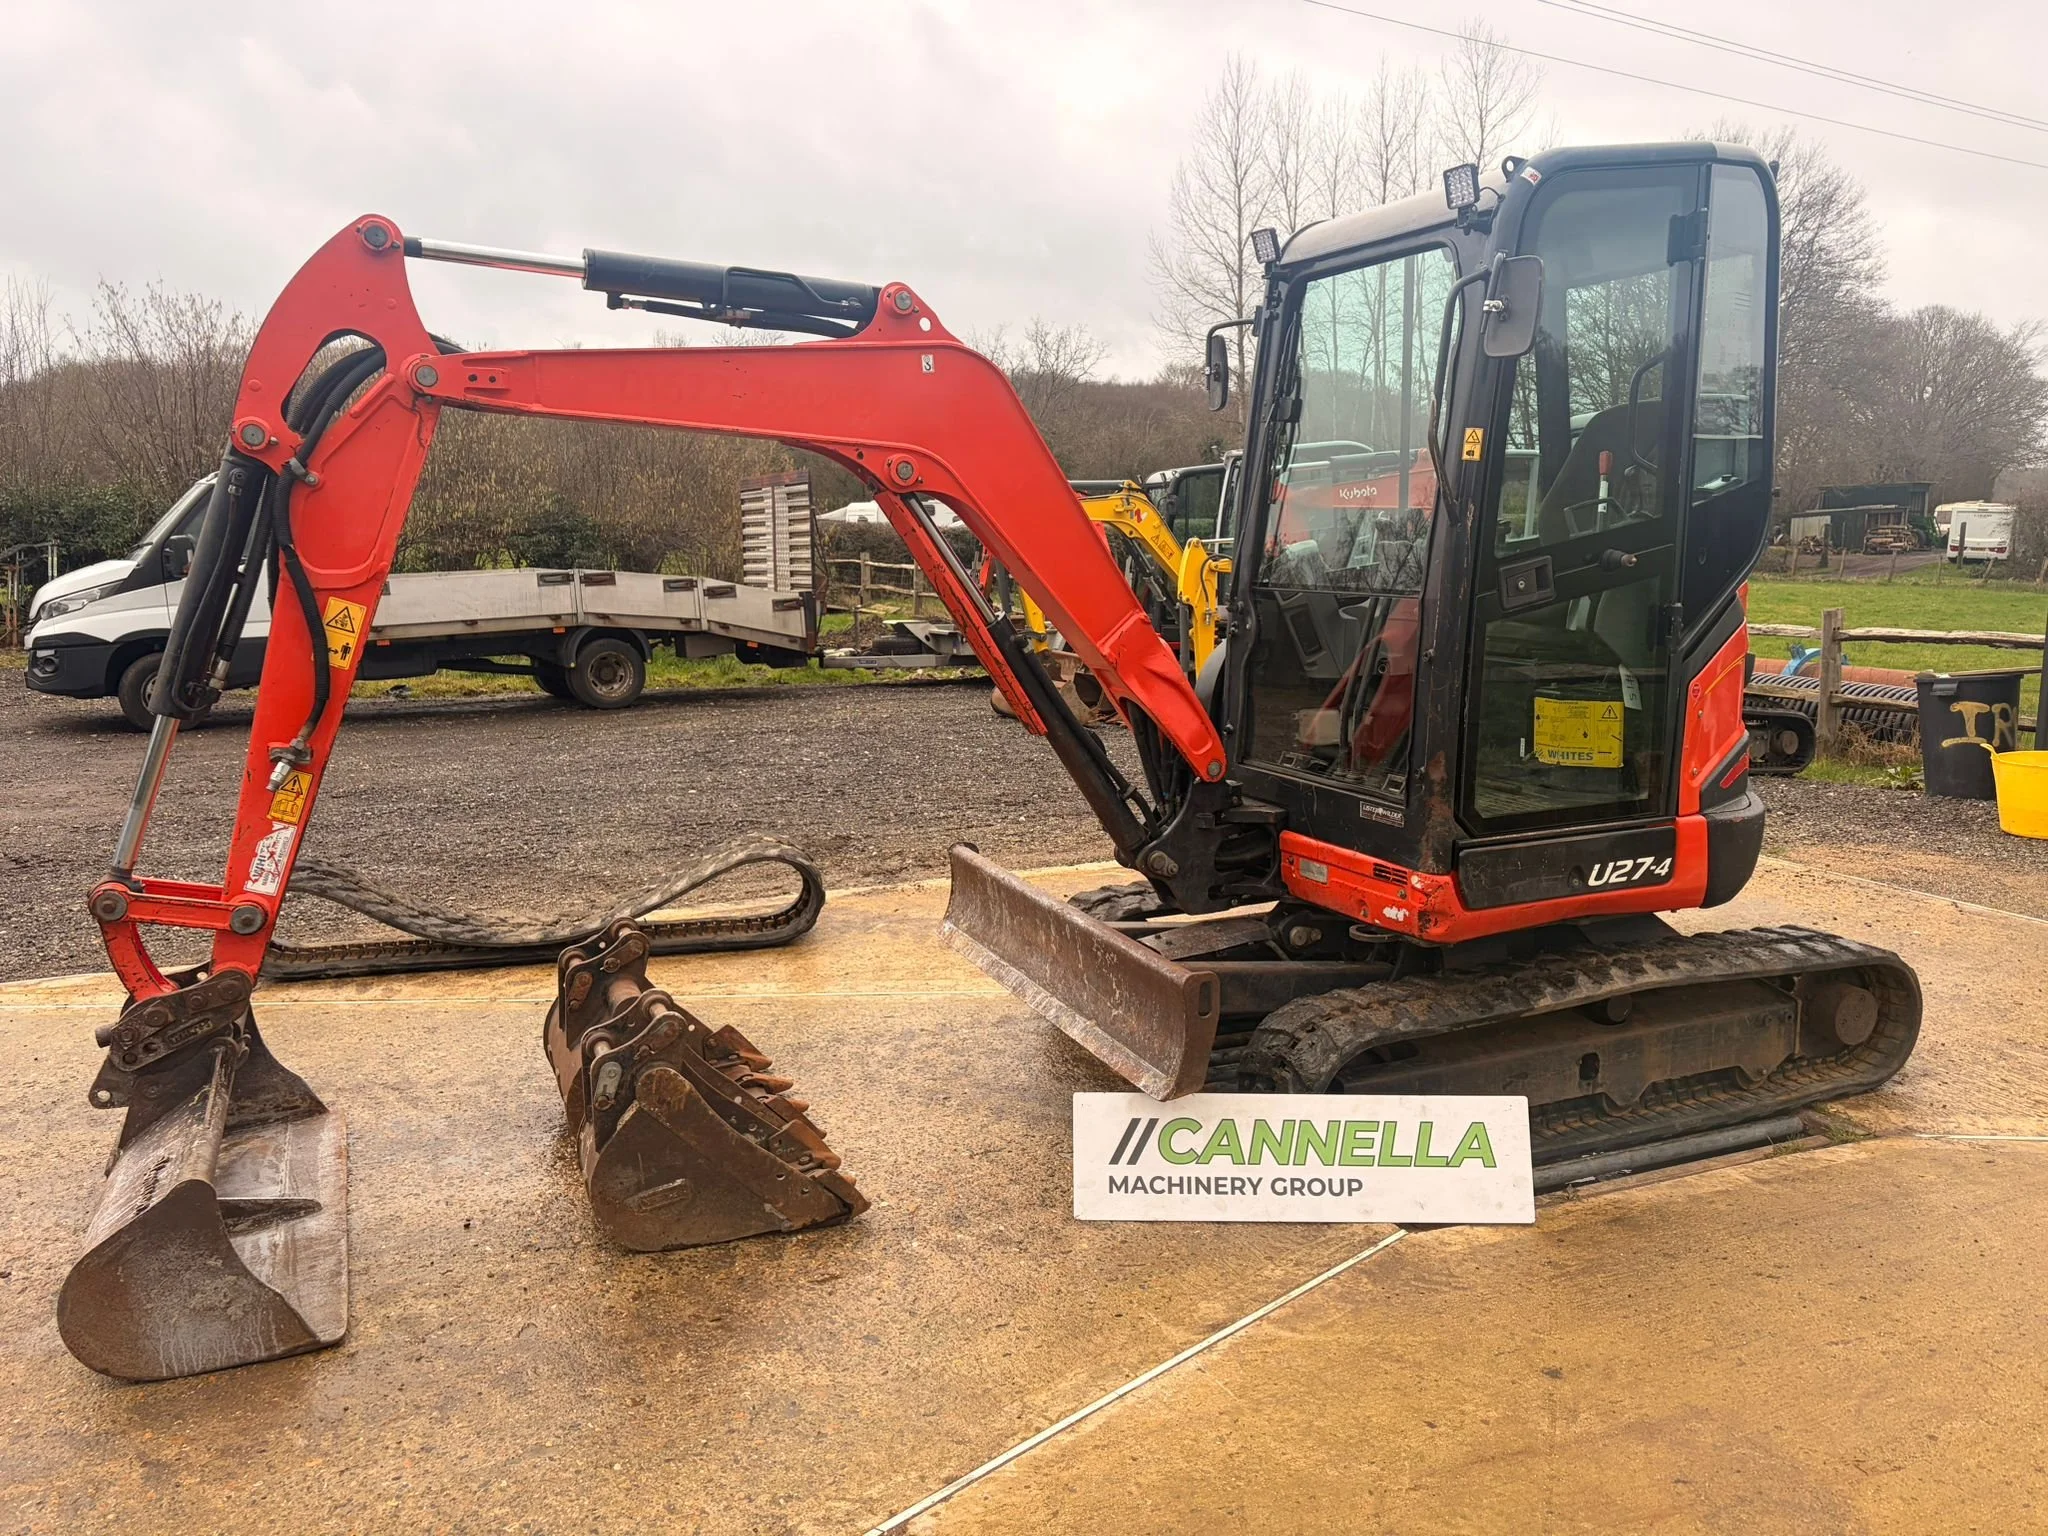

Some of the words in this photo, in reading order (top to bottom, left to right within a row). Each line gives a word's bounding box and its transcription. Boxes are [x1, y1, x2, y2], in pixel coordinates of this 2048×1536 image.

[1339, 485, 1377, 499] Kubota
[1547, 749, 1594, 761] WHITES
[1587, 856, 1672, 887] U27-4
[1108, 1175, 1263, 1196] MACHINERY
[1270, 1177, 1363, 1197] GROUP
